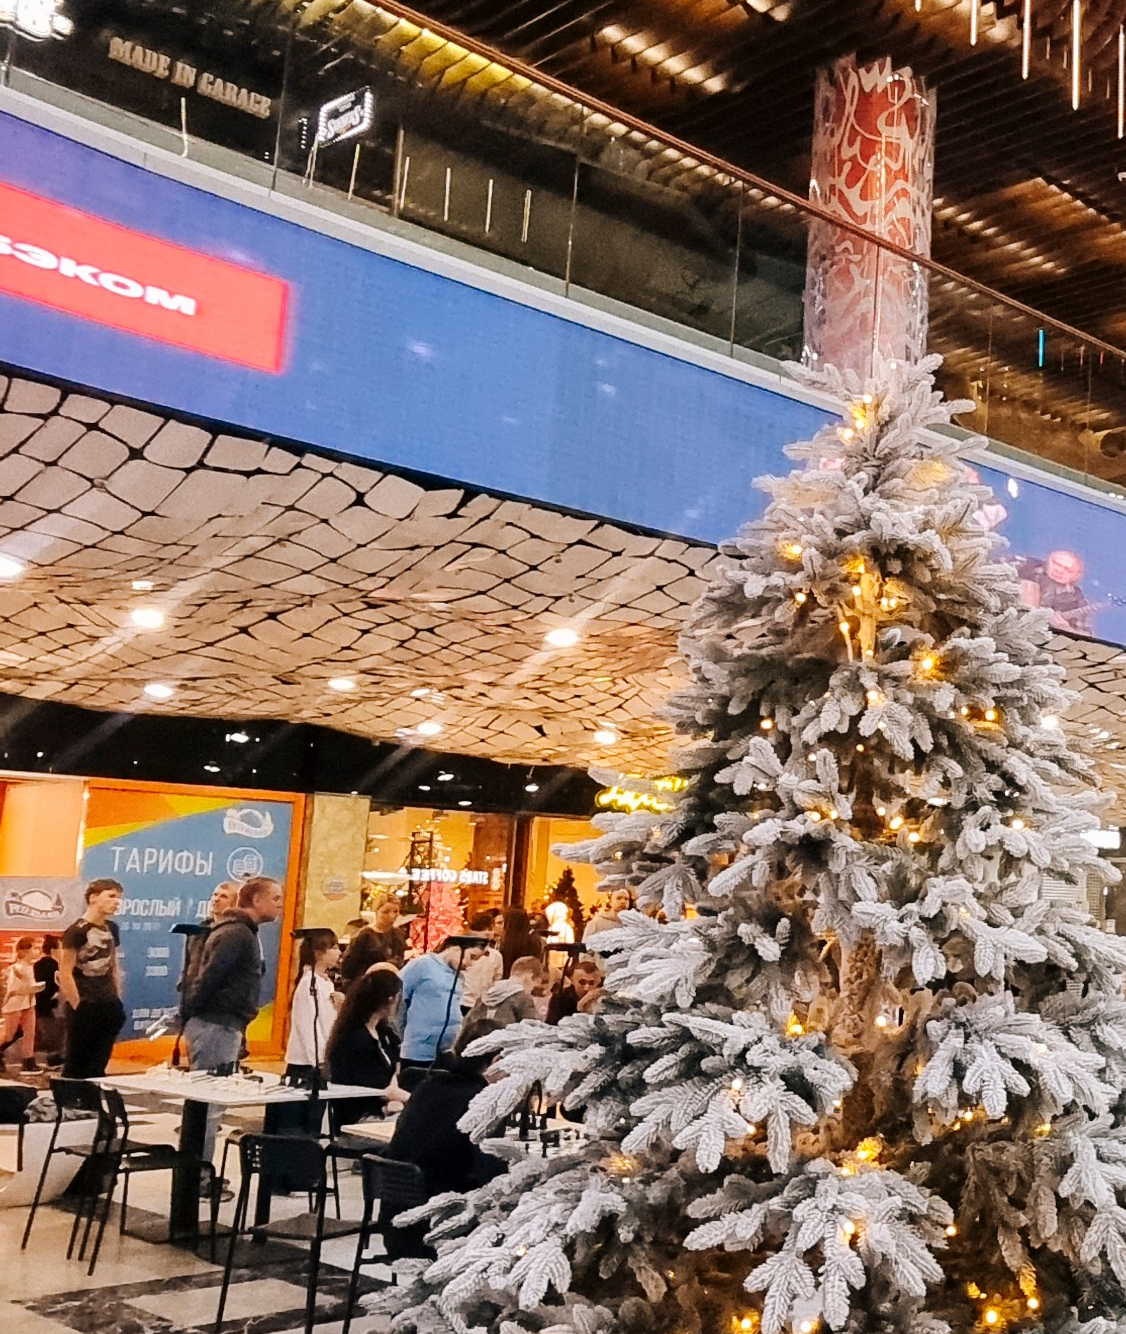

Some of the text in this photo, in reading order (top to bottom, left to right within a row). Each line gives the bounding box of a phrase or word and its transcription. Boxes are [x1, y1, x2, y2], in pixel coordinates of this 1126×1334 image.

[108, 36, 272, 119] MADE IN GARAGE
[111, 846, 214, 876] ТАРИФЫ
[113, 895, 181, 917] ЗРОСЛЫЙ
